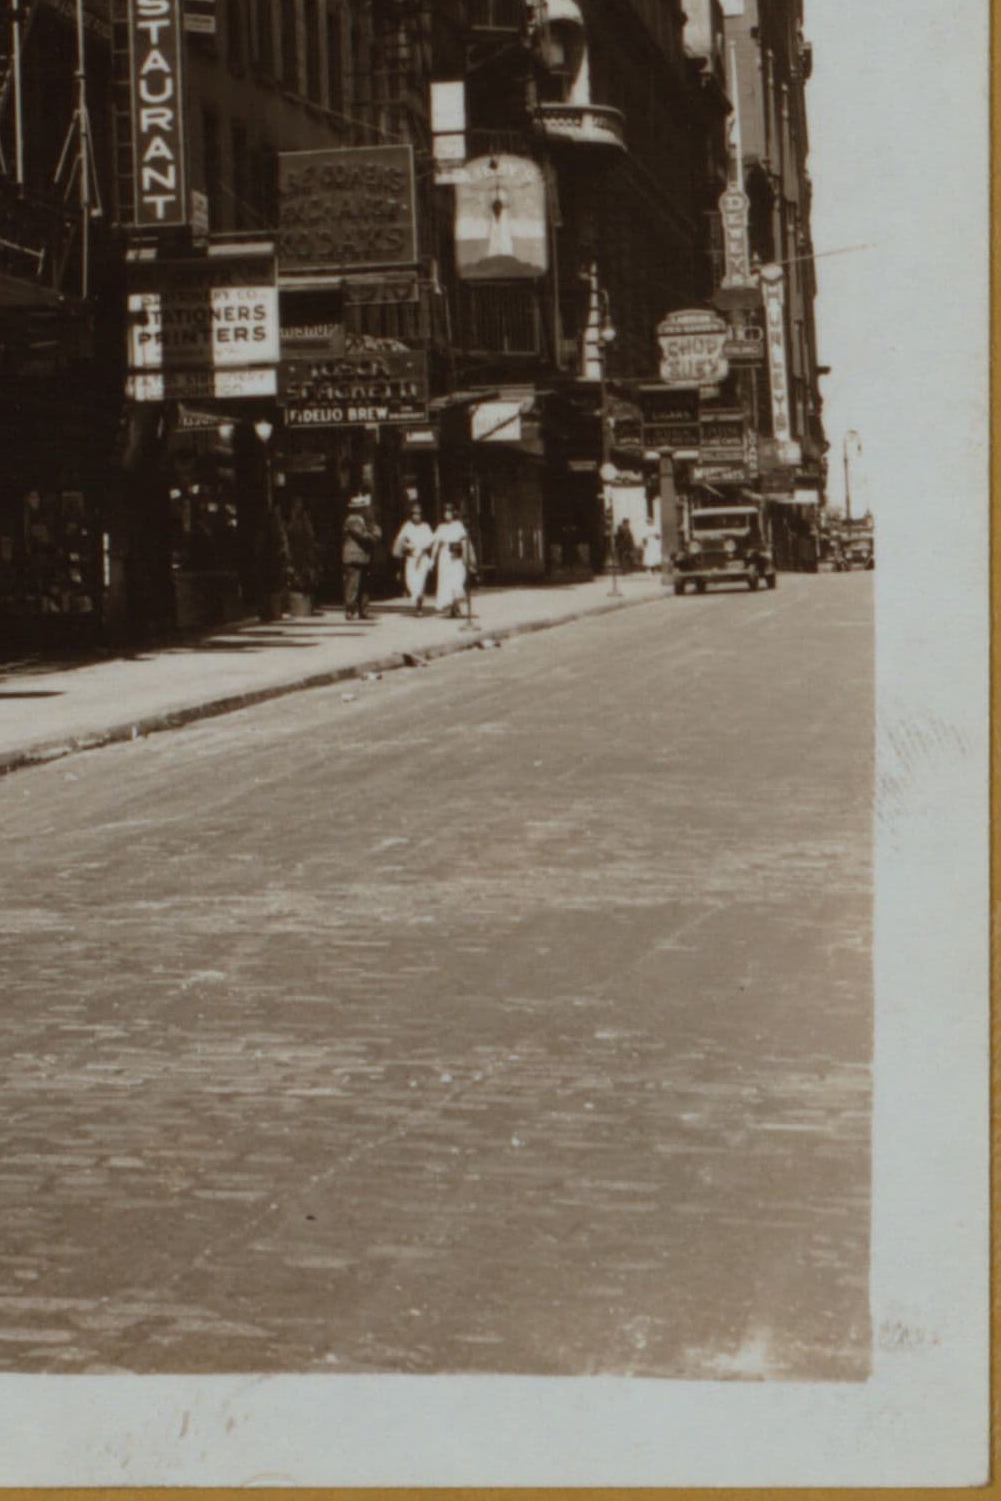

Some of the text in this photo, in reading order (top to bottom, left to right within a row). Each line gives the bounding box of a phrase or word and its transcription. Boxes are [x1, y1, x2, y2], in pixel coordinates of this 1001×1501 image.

[138, 304, 267, 326] TATIONERS
[138, 326, 267, 346] PRINTERS
[667, 337, 717, 357] CHOP
[347, 406, 389, 421] BREW
